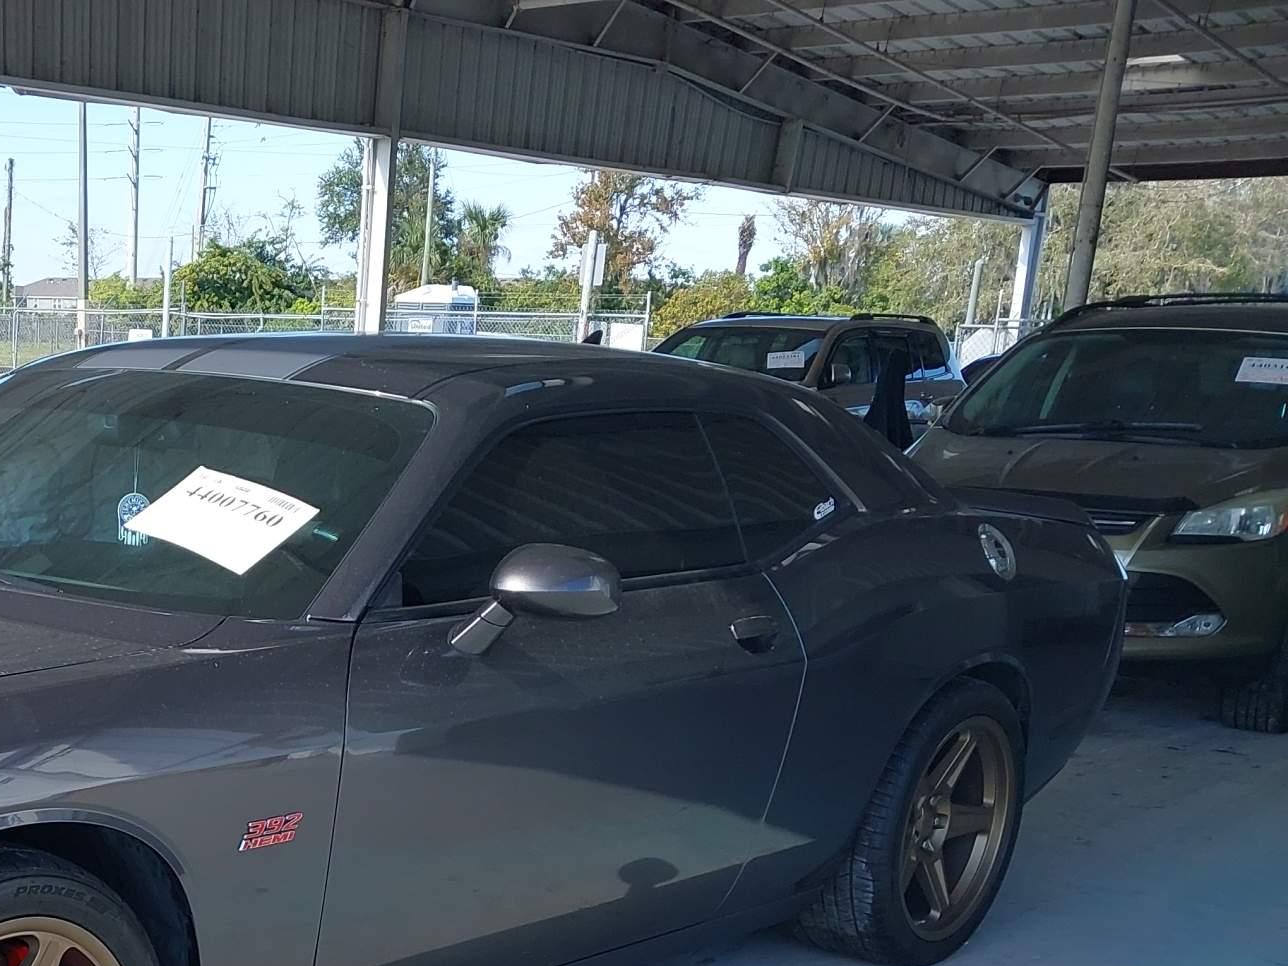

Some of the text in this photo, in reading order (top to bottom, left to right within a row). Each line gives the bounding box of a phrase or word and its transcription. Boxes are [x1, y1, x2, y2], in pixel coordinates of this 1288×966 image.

[186, 486, 284, 527] 44007760
[242, 811, 303, 840] 392
[238, 830, 296, 852] HEMI
[14, 884, 87, 901] PROXES
